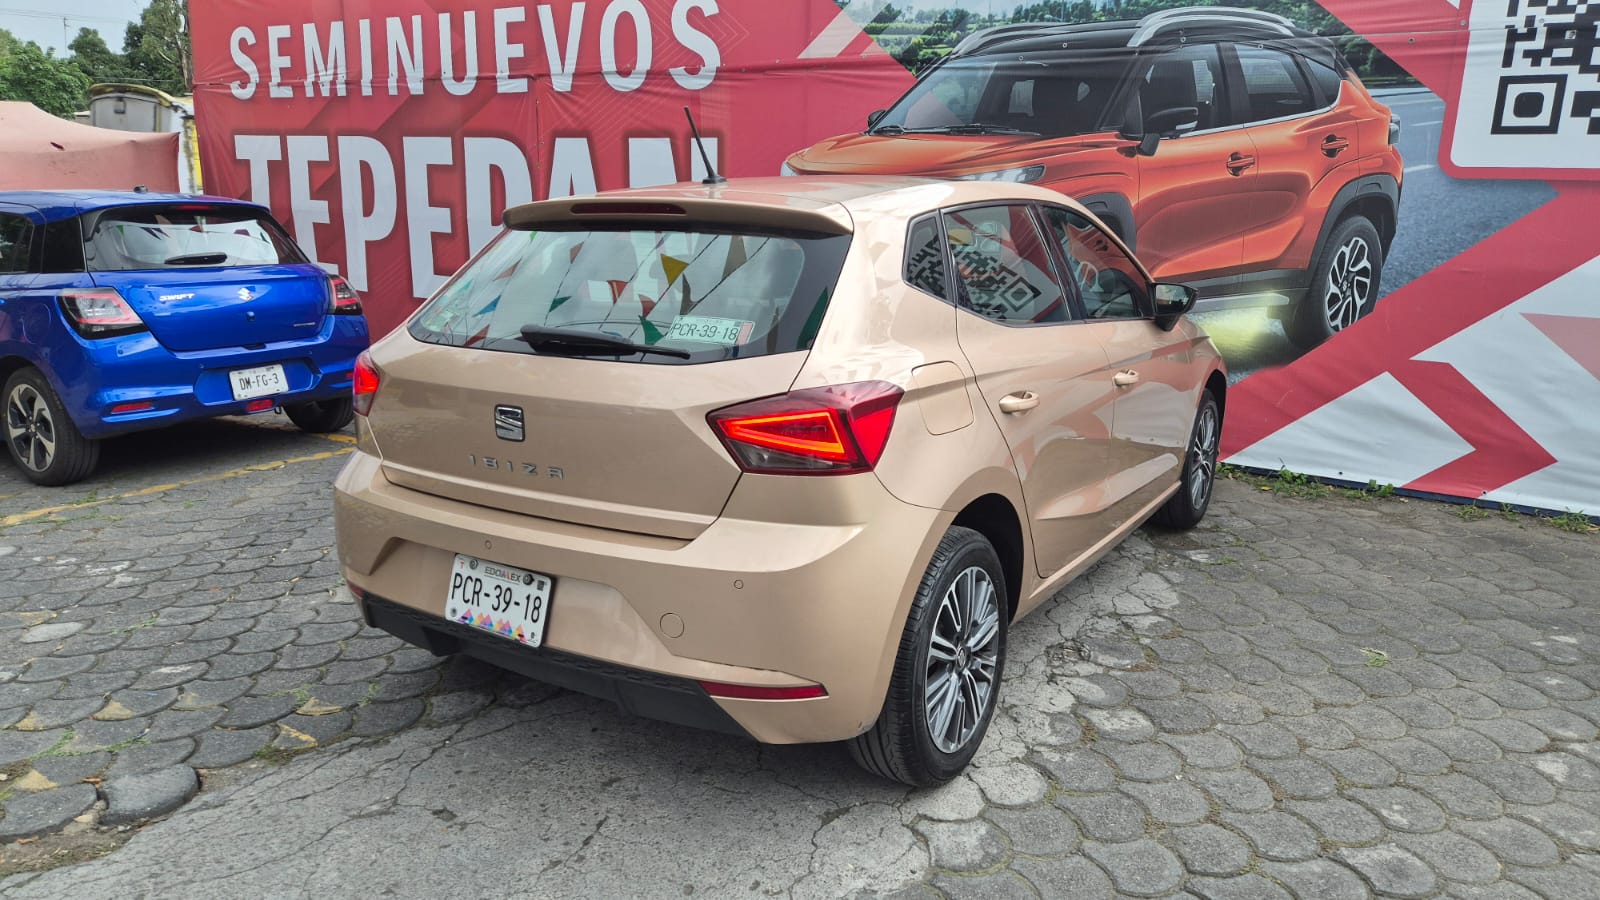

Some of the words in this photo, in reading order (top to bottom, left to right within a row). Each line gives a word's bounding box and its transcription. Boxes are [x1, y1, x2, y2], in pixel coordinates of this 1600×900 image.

[229, 0, 722, 99] SEMINUEVOS
[234, 134, 719, 299] TEPEP
[159, 292, 196, 302] SWIFT
[670, 322, 739, 341] PCR-39-18
[239, 372, 280, 391] DM-FG-3
[468, 453, 564, 481] IBIZA
[451, 572, 542, 624] PCR-39-18
